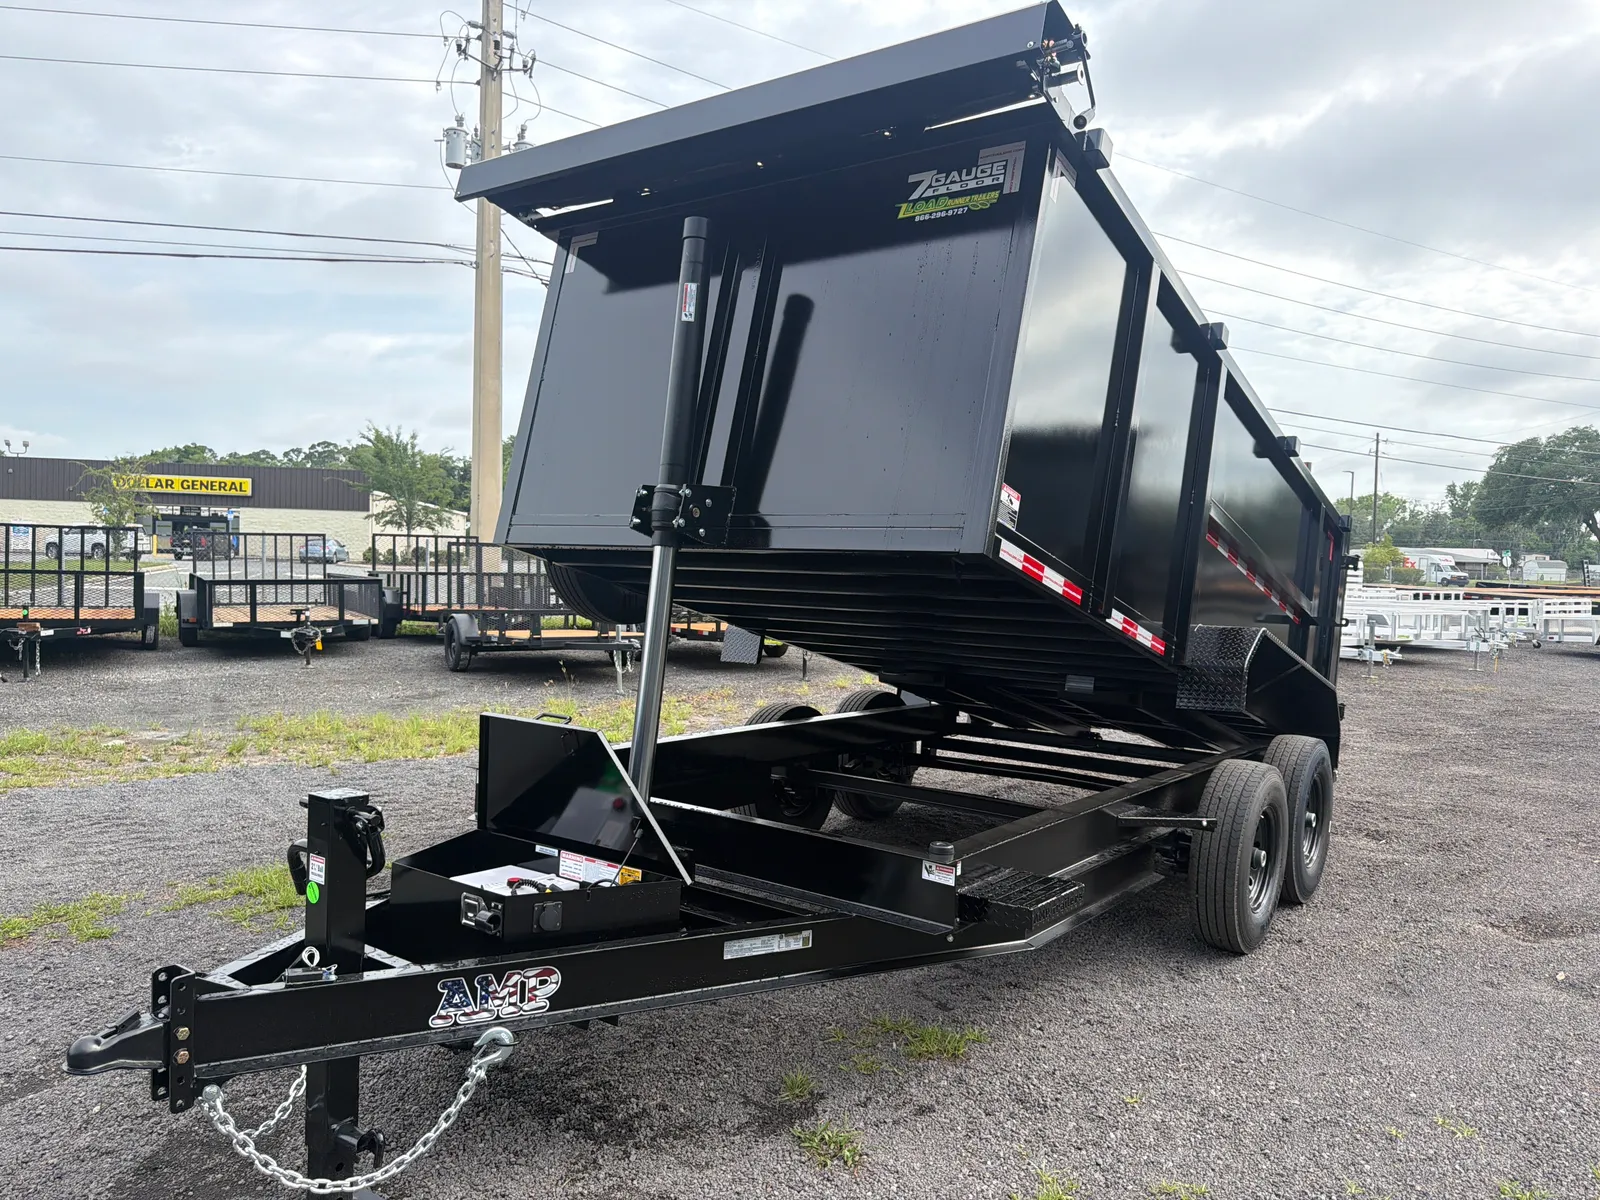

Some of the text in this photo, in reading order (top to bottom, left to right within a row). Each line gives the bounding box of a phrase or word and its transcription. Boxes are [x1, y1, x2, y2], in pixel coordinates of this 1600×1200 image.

[907, 169, 938, 201] 7
[931, 160, 1007, 187] GAUGE
[932, 176, 1001, 194] FLOOR
[904, 196, 949, 214] LOAD
[947, 195, 971, 206] RUNNER
[970, 190, 1000, 202] TRAILERS
[914, 206, 968, 222] 866-296-9727
[180, 479, 247, 493] GENERAL
[1403, 557, 1416, 568] Ex
[429, 965, 562, 1028] AMP
